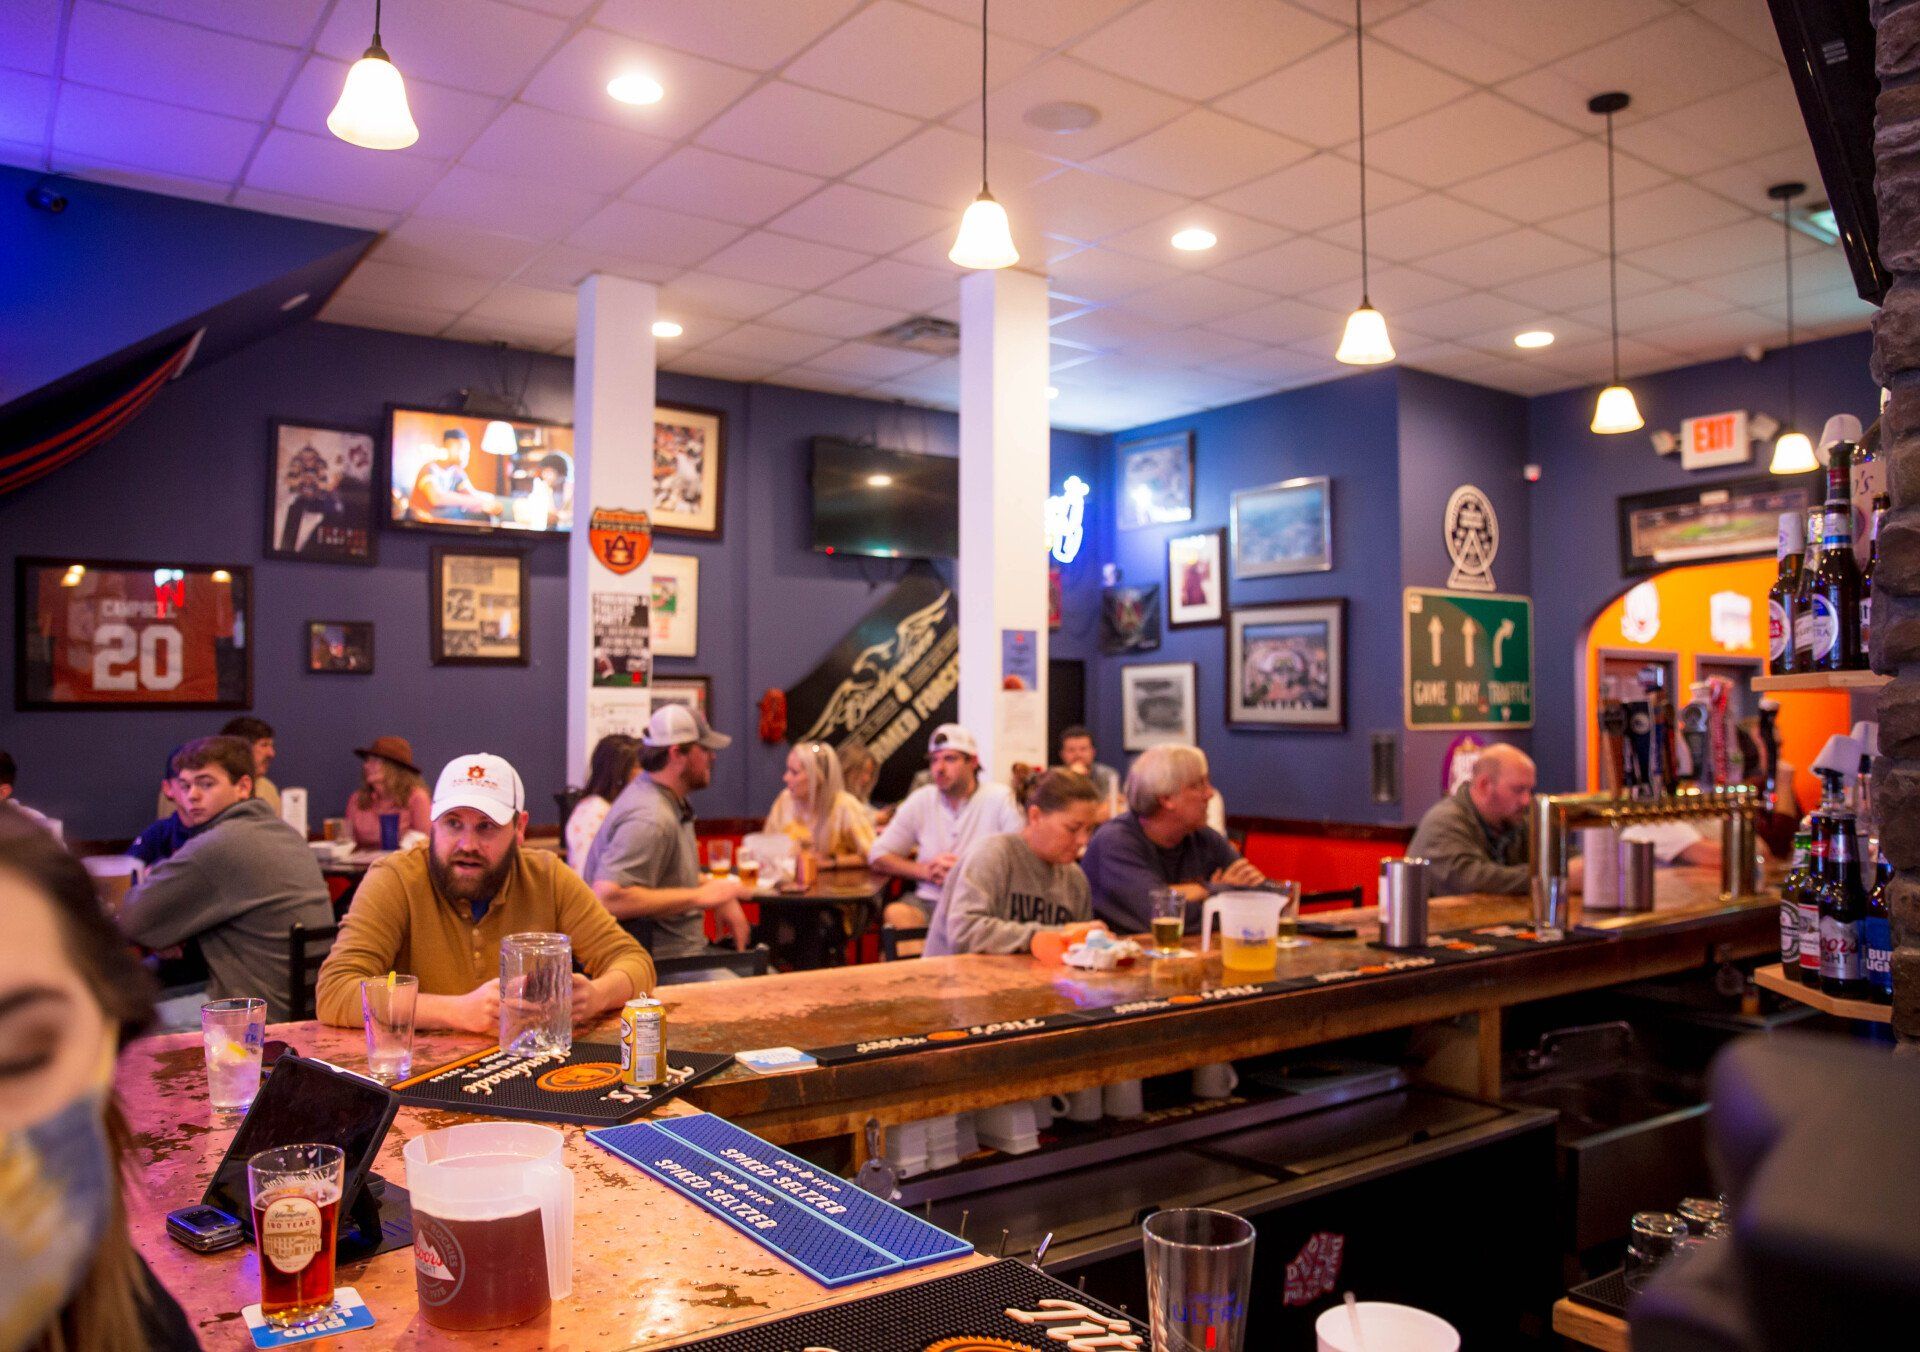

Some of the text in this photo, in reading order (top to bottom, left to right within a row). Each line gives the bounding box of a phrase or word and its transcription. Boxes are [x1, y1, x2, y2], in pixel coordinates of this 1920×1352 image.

[1693, 413, 1736, 454] EXIT
[92, 622, 184, 691] 20
[654, 1158, 778, 1230] SPIKED SELTZER
[720, 1148, 847, 1215] SPIKED SELTZER
[286, 1218, 316, 1229] YEARS
[283, 1317, 347, 1338] BUD
[1173, 1303, 1244, 1324] ULTRA
